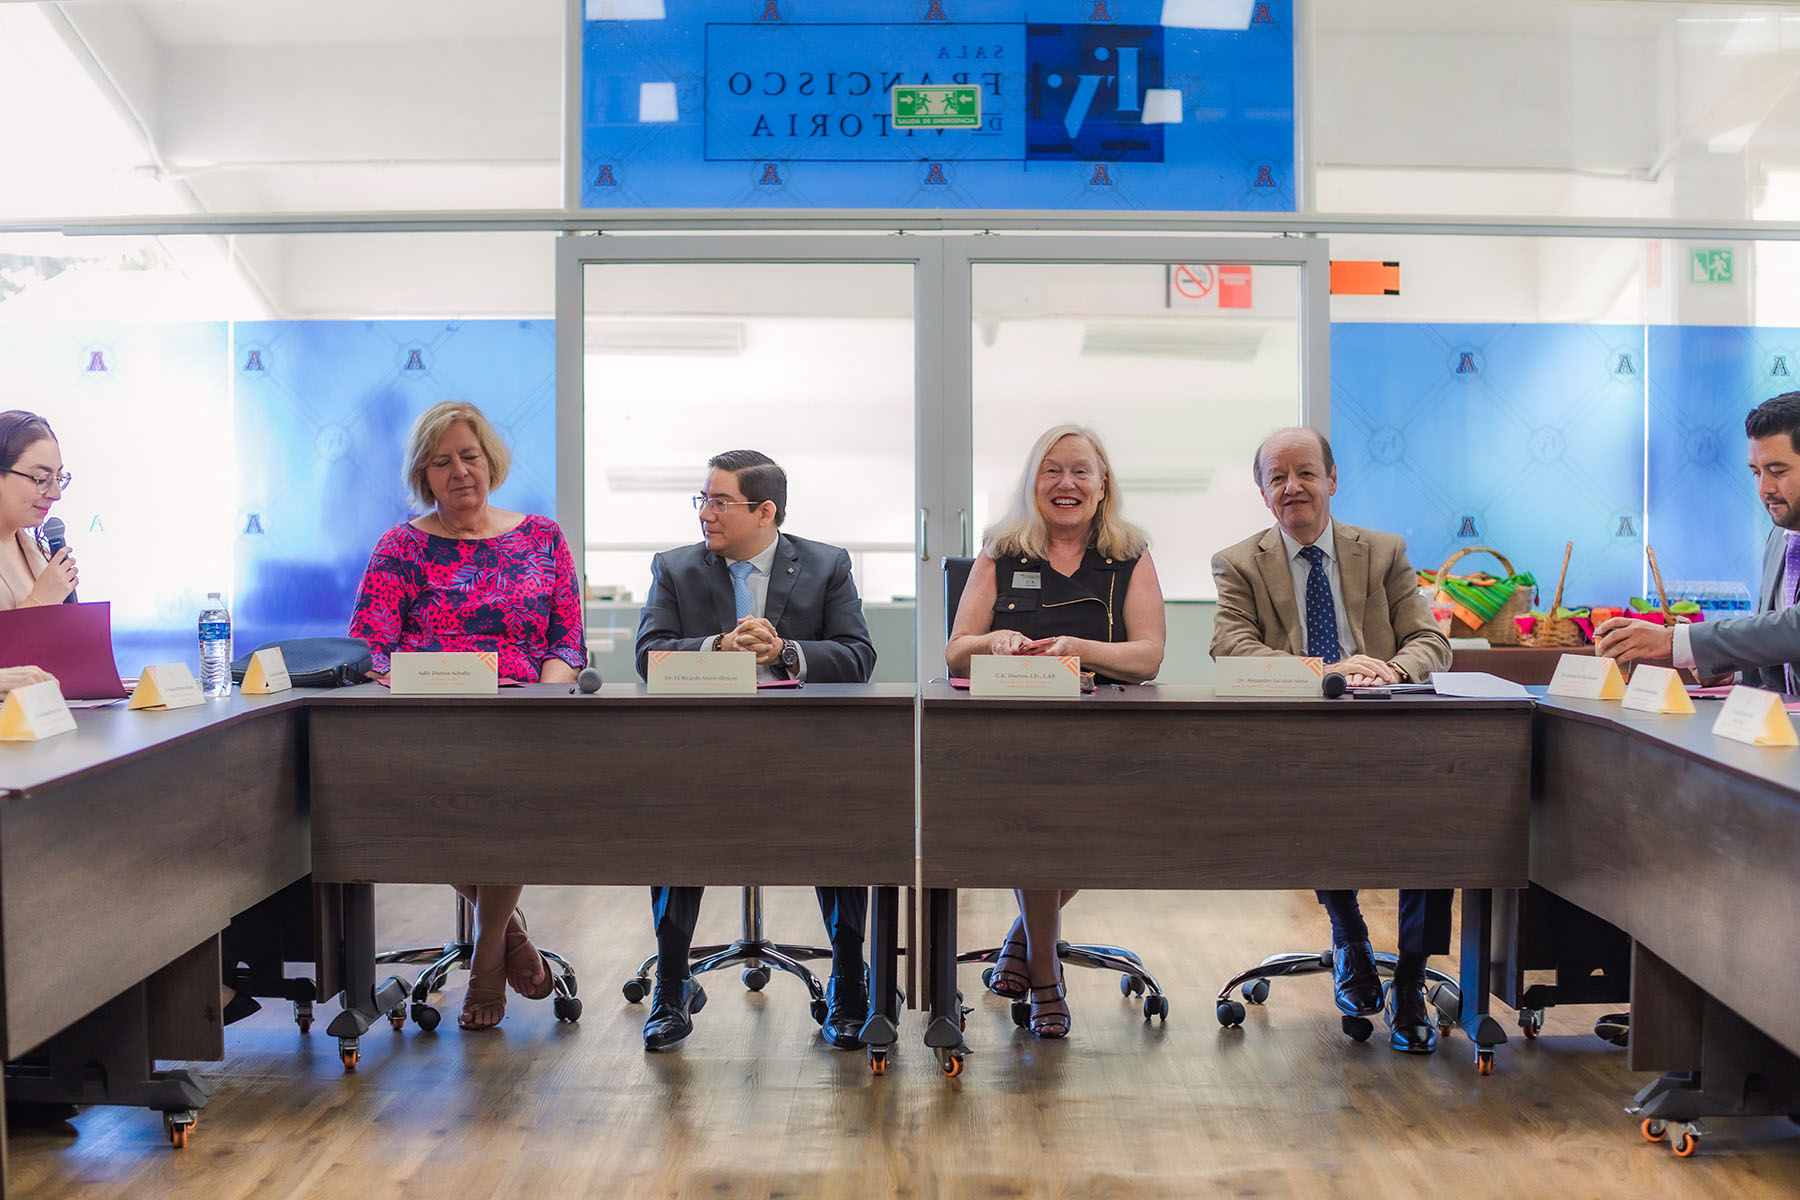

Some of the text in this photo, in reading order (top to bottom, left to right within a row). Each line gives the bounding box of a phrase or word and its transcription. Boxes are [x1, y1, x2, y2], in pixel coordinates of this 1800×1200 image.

[594, 164, 616, 186] A
[759, 164, 781, 186] A
[924, 164, 947, 186] A
[1090, 164, 1112, 186] A
[1254, 166, 1277, 187] A
[86, 351, 107, 372] A
[244, 350, 265, 371] A
[404, 349, 426, 371] A
[1456, 352, 1478, 374] A
[1615, 353, 1637, 375] A
[1769, 354, 1791, 376] A
[244, 513, 265, 535] A
[1457, 516, 1479, 538] A
[1615, 517, 1637, 539] A
